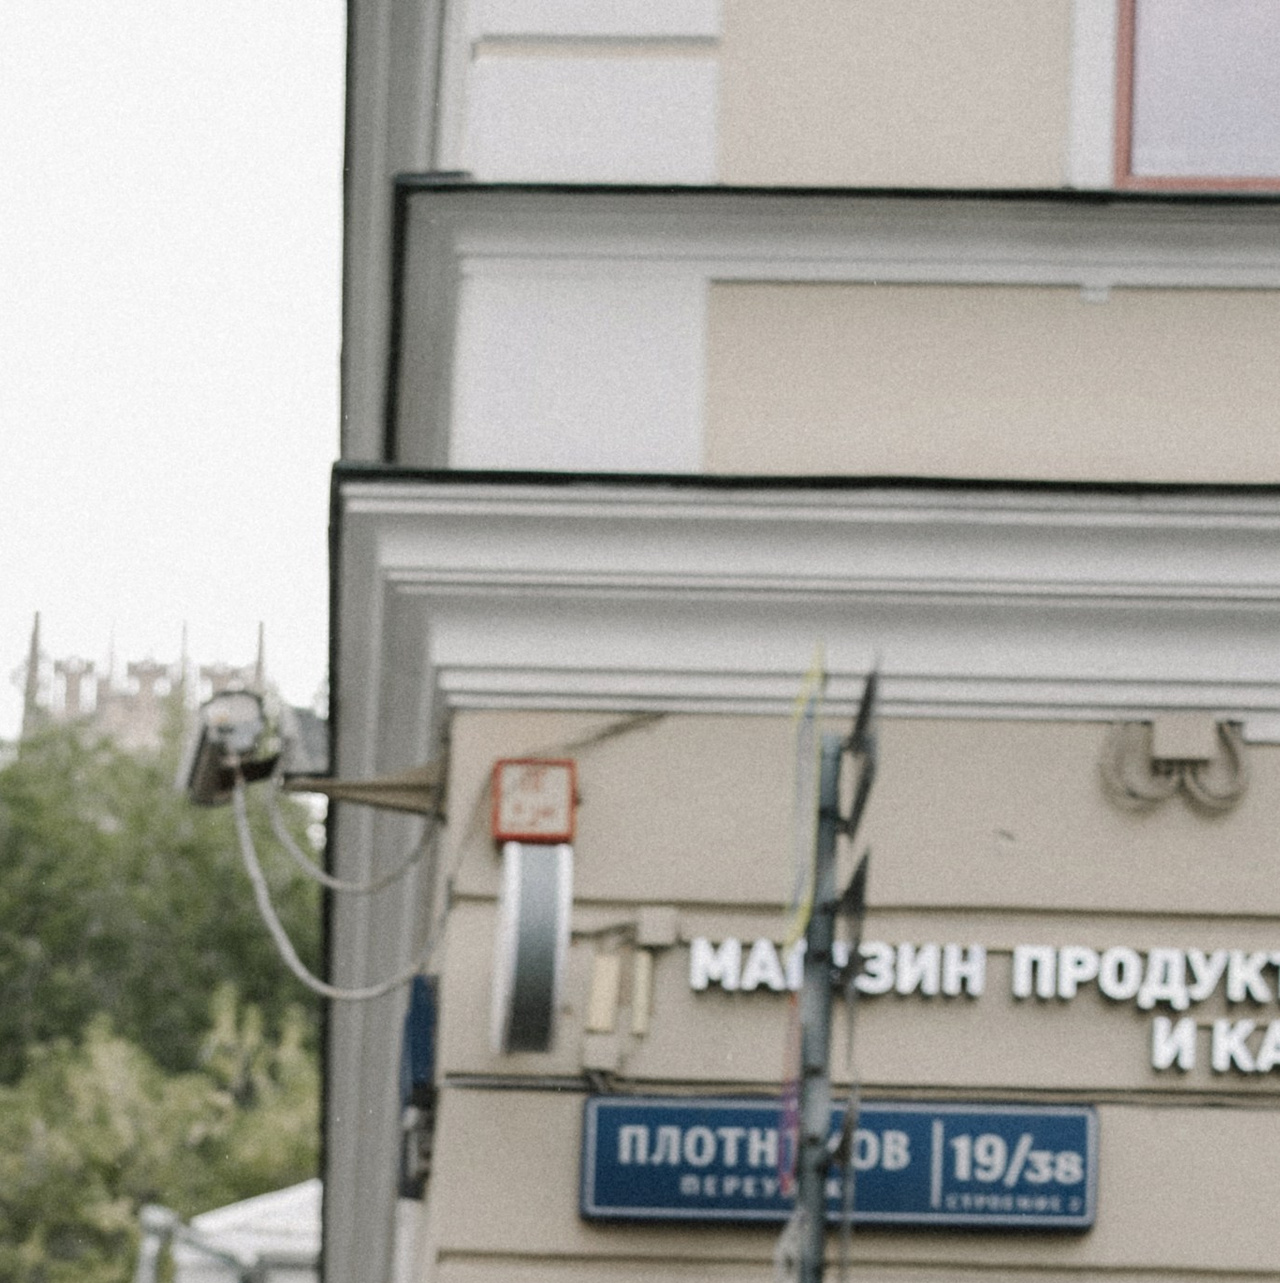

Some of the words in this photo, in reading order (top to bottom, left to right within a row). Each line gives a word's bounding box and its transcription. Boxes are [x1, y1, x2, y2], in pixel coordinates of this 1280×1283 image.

[689, 936, 986, 996] МАГЗИН
[1151, 1017, 1197, 1071] И
[618, 1124, 911, 1172] ПЛОТНОВ
[949, 1132, 1085, 1188] 19/38
[679, 1175, 844, 1199] ПЕРЕУК
